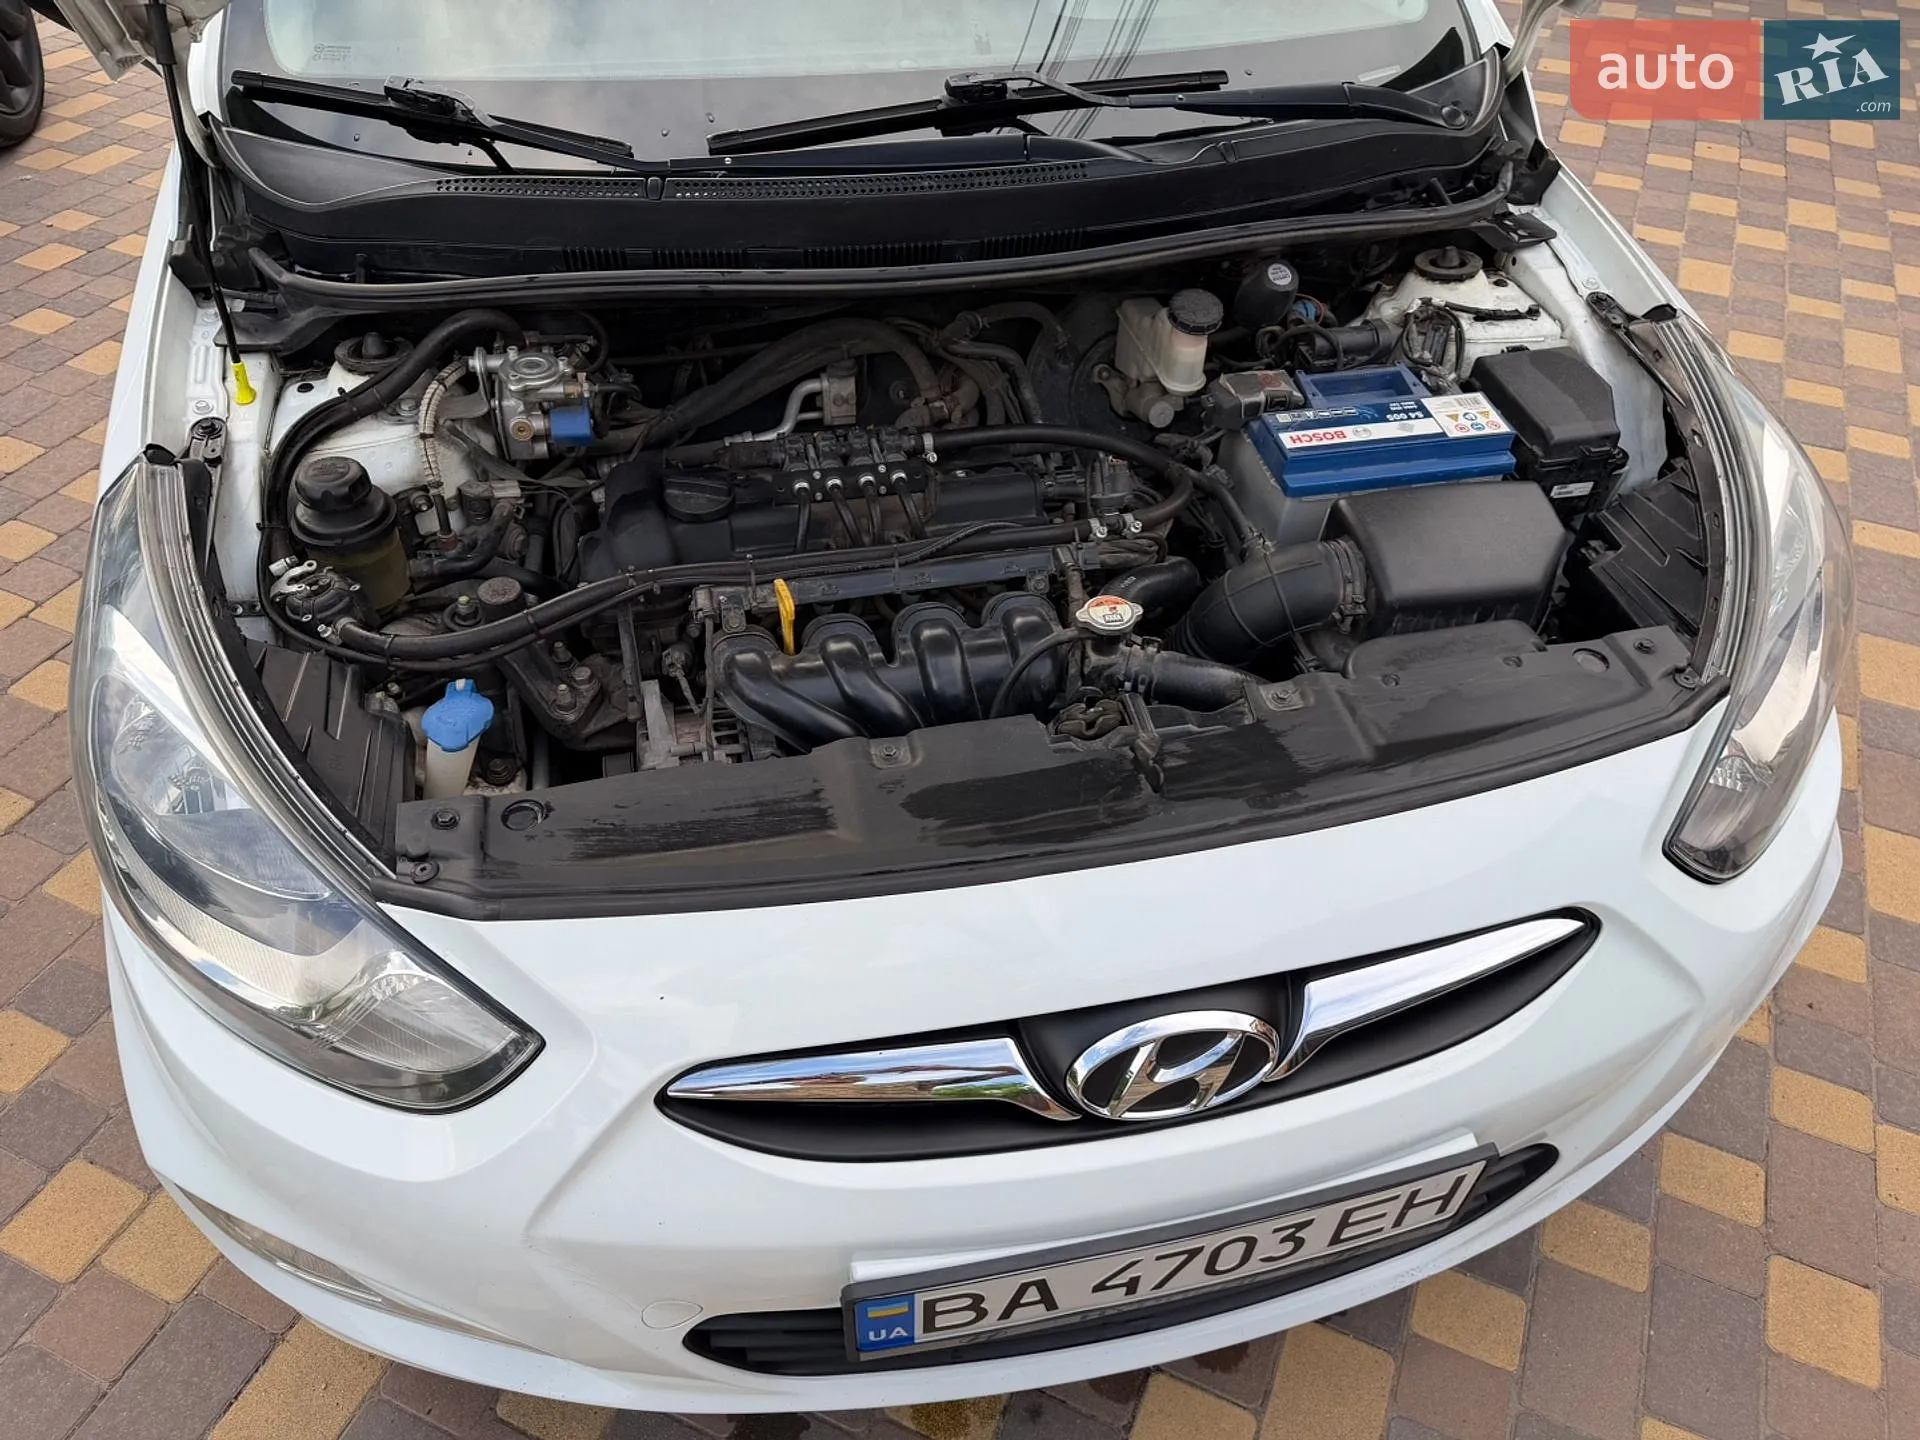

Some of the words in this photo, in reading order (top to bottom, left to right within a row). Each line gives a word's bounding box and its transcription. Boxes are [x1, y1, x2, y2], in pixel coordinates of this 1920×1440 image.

[1289, 430, 1347, 444] BOSCH
[922, 1278, 1060, 1334] BA
[1091, 1217, 1315, 1297] 4703
[1327, 1174, 1466, 1248] EH
[868, 1327, 908, 1341] UA
